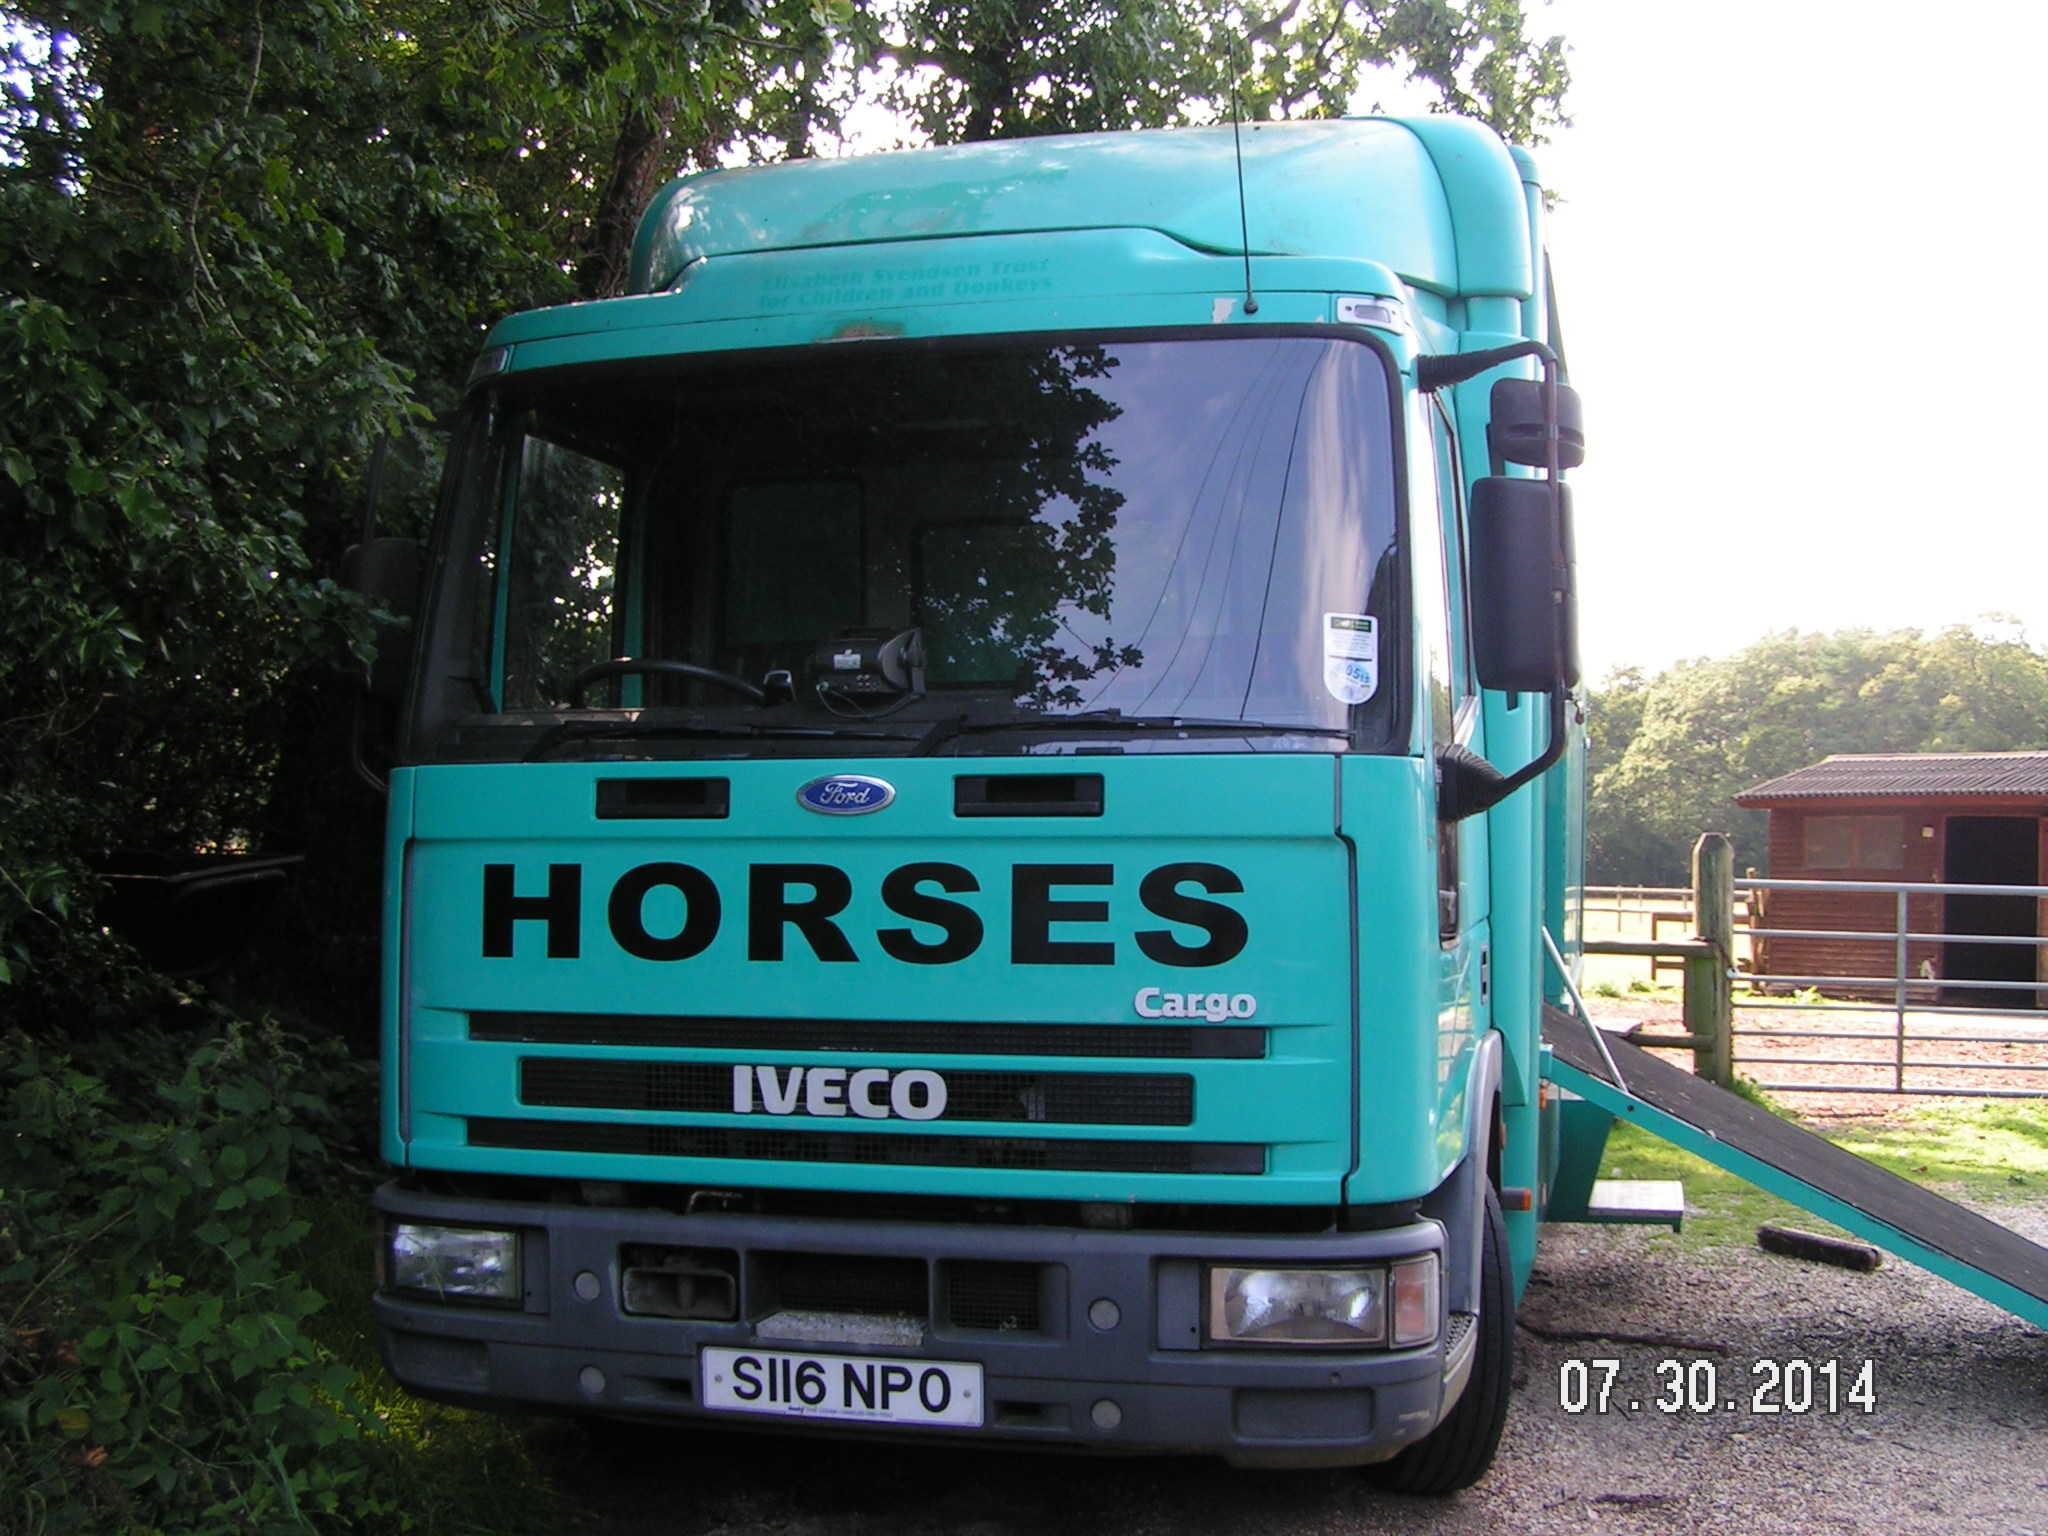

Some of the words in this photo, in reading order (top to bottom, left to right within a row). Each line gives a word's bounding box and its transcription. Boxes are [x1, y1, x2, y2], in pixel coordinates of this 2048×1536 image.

[989, 257, 1050, 276] Trust
[758, 292, 790, 309] for
[797, 285, 894, 307] Children
[900, 281, 945, 300] and
[952, 275, 1055, 297] Donkeys
[820, 781, 872, 805] Ford
[481, 861, 1250, 968] HORSES
[1133, 986, 1258, 1023] Cargo
[732, 1063, 949, 1122] IVECO
[732, 1356, 827, 1405] S116
[842, 1362, 951, 1413] NPO
